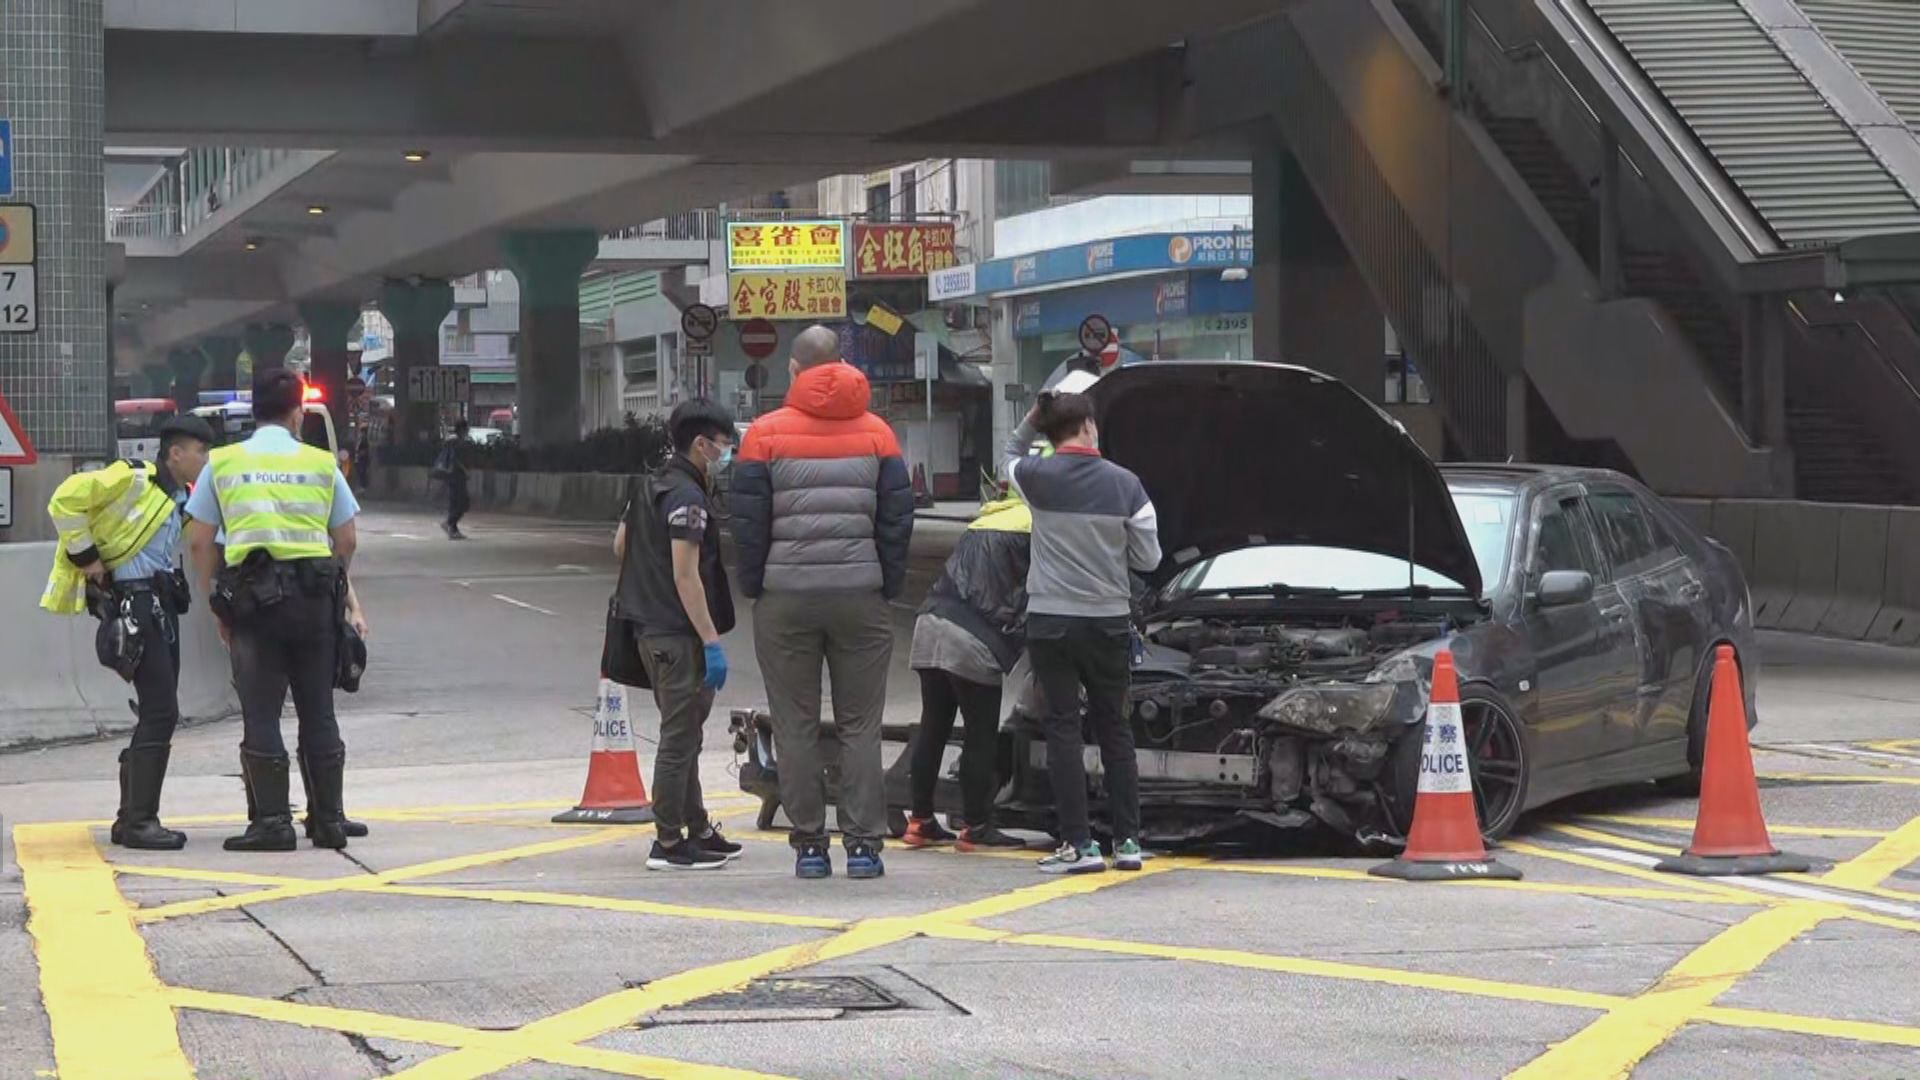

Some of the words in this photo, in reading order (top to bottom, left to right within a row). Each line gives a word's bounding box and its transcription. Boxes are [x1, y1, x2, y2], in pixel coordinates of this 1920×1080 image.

[858, 228, 924, 273] 金旺角
[2, 272, 16, 291] 7
[3, 304, 28, 323] 12
[256, 472, 291, 484] POLICE
